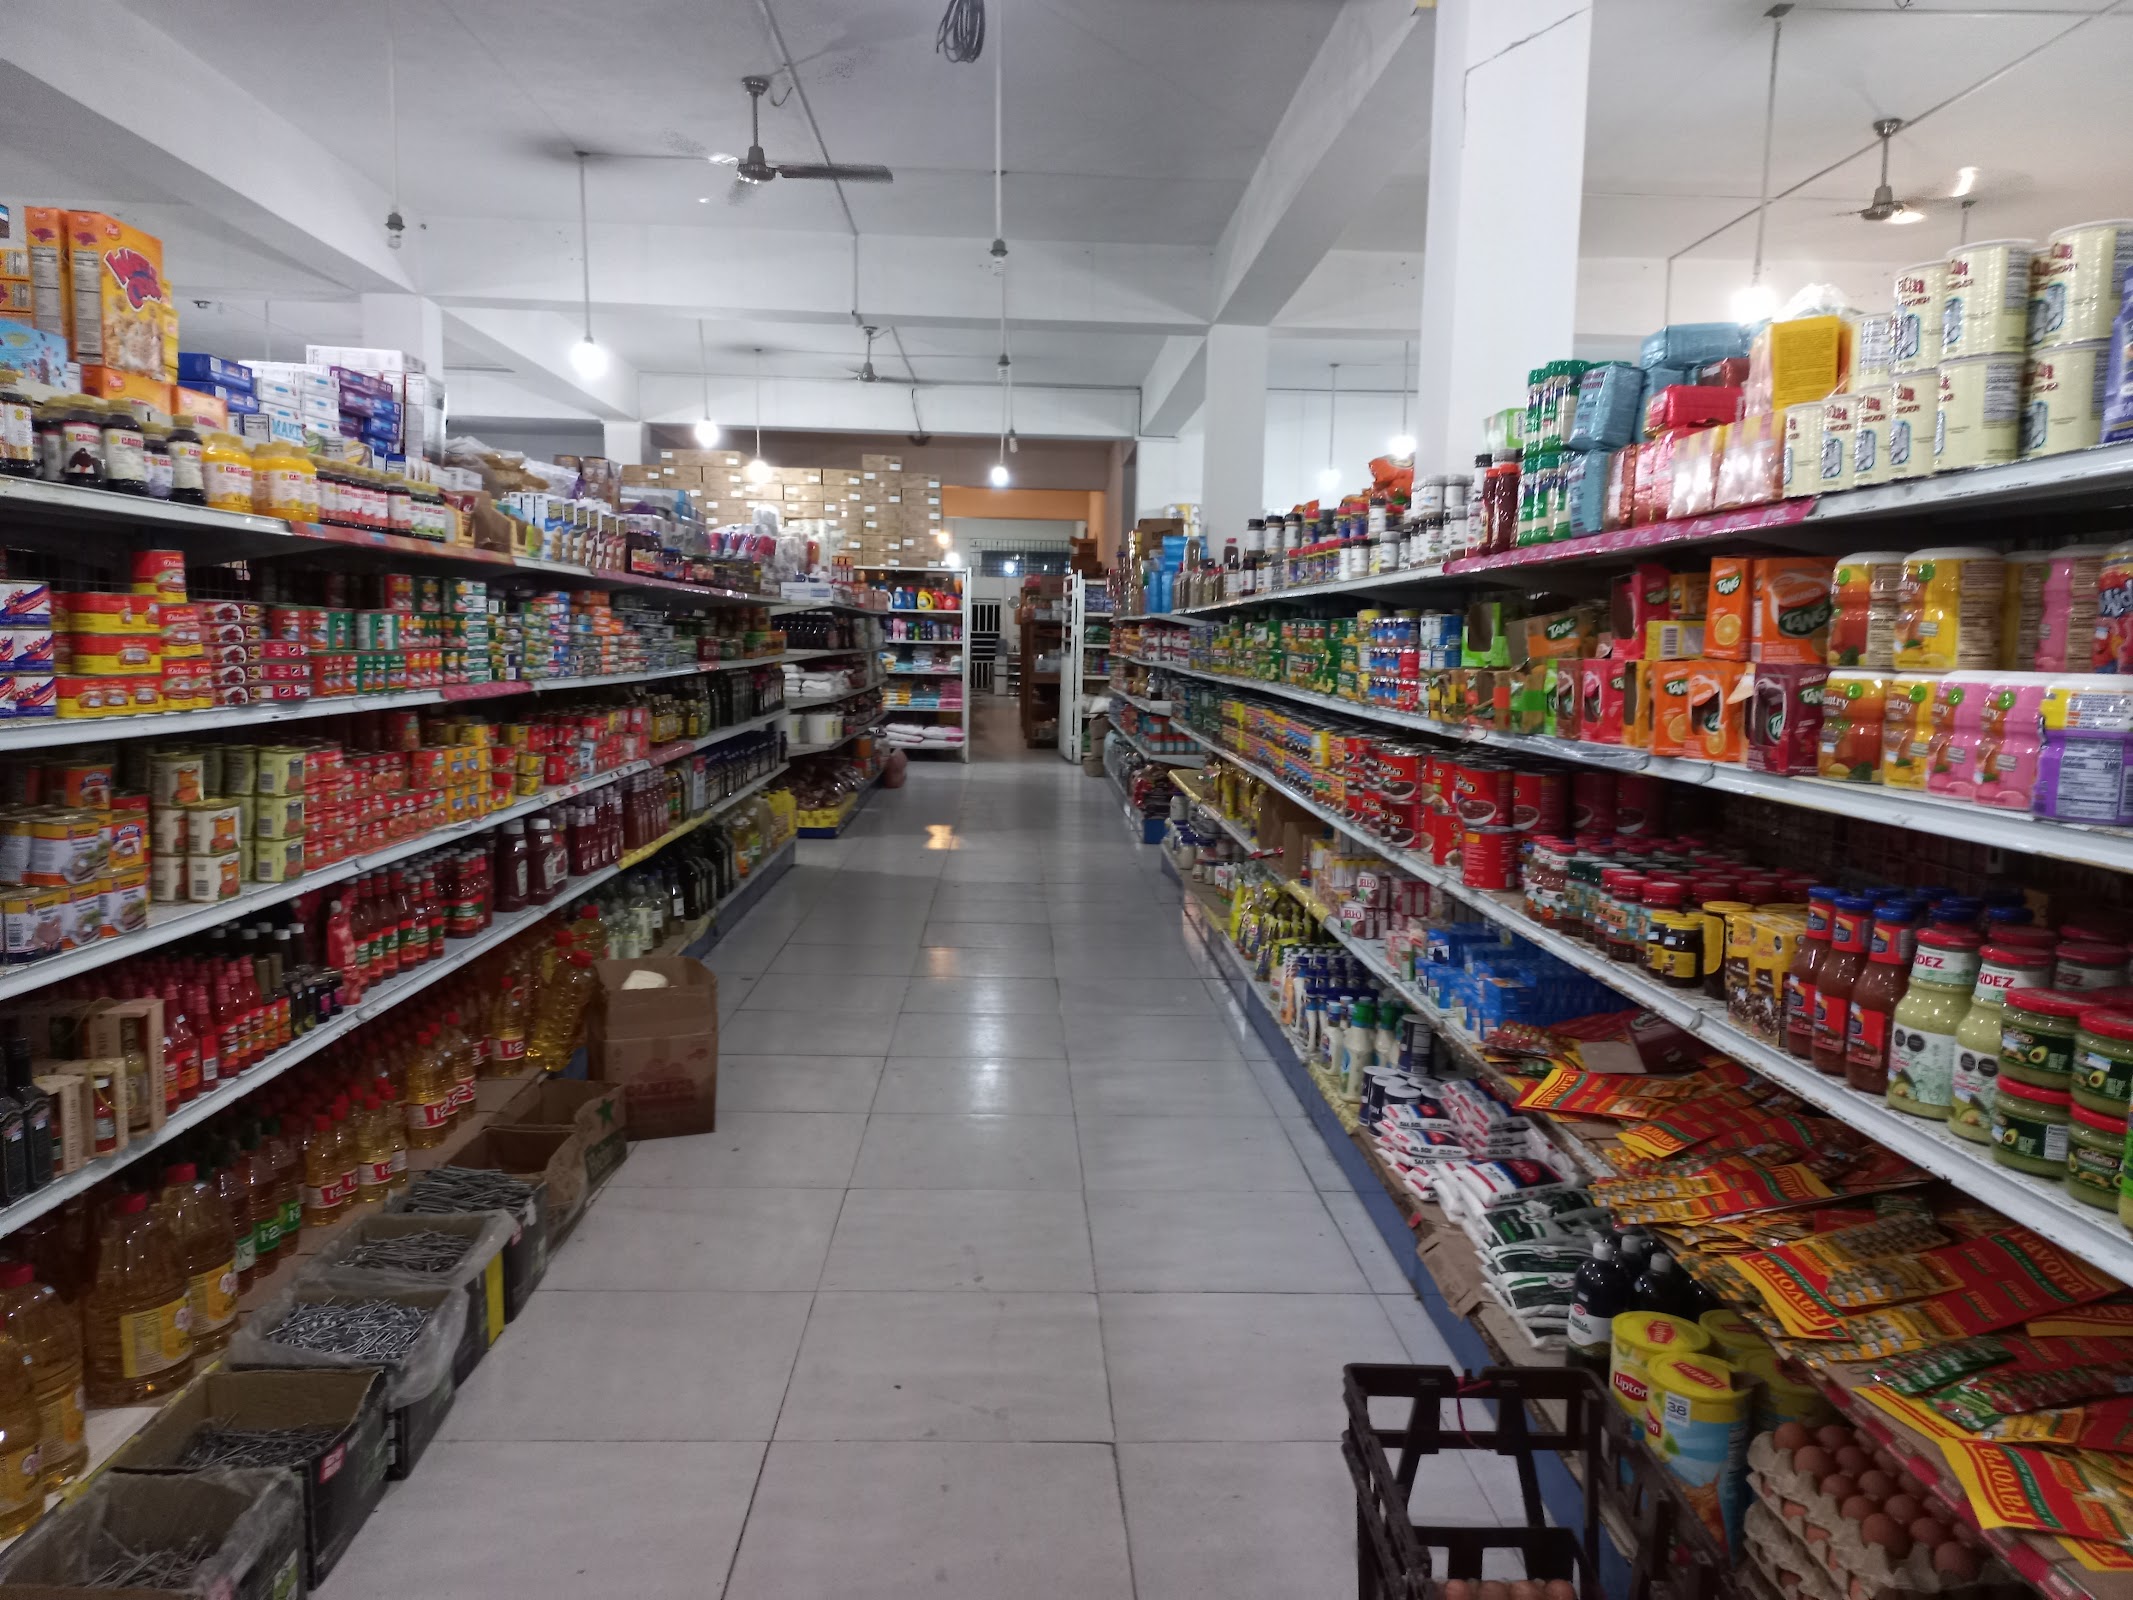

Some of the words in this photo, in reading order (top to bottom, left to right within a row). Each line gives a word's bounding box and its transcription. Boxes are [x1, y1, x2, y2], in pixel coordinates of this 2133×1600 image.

[1717, 575, 1740, 594] TANG
[1547, 618, 1576, 639] TANG
[1781, 606, 1829, 632] TANG
[25, 636, 47, 652] DAK
[13, 682, 41, 700] DAK
[1800, 687, 1825, 704] TAN
[1757, 1258, 1832, 1322] Favora
[1679, 1362, 1723, 1389] Lipton
[1667, 1401, 1687, 1416] 38
[1980, 1447, 2036, 1522] Favora
